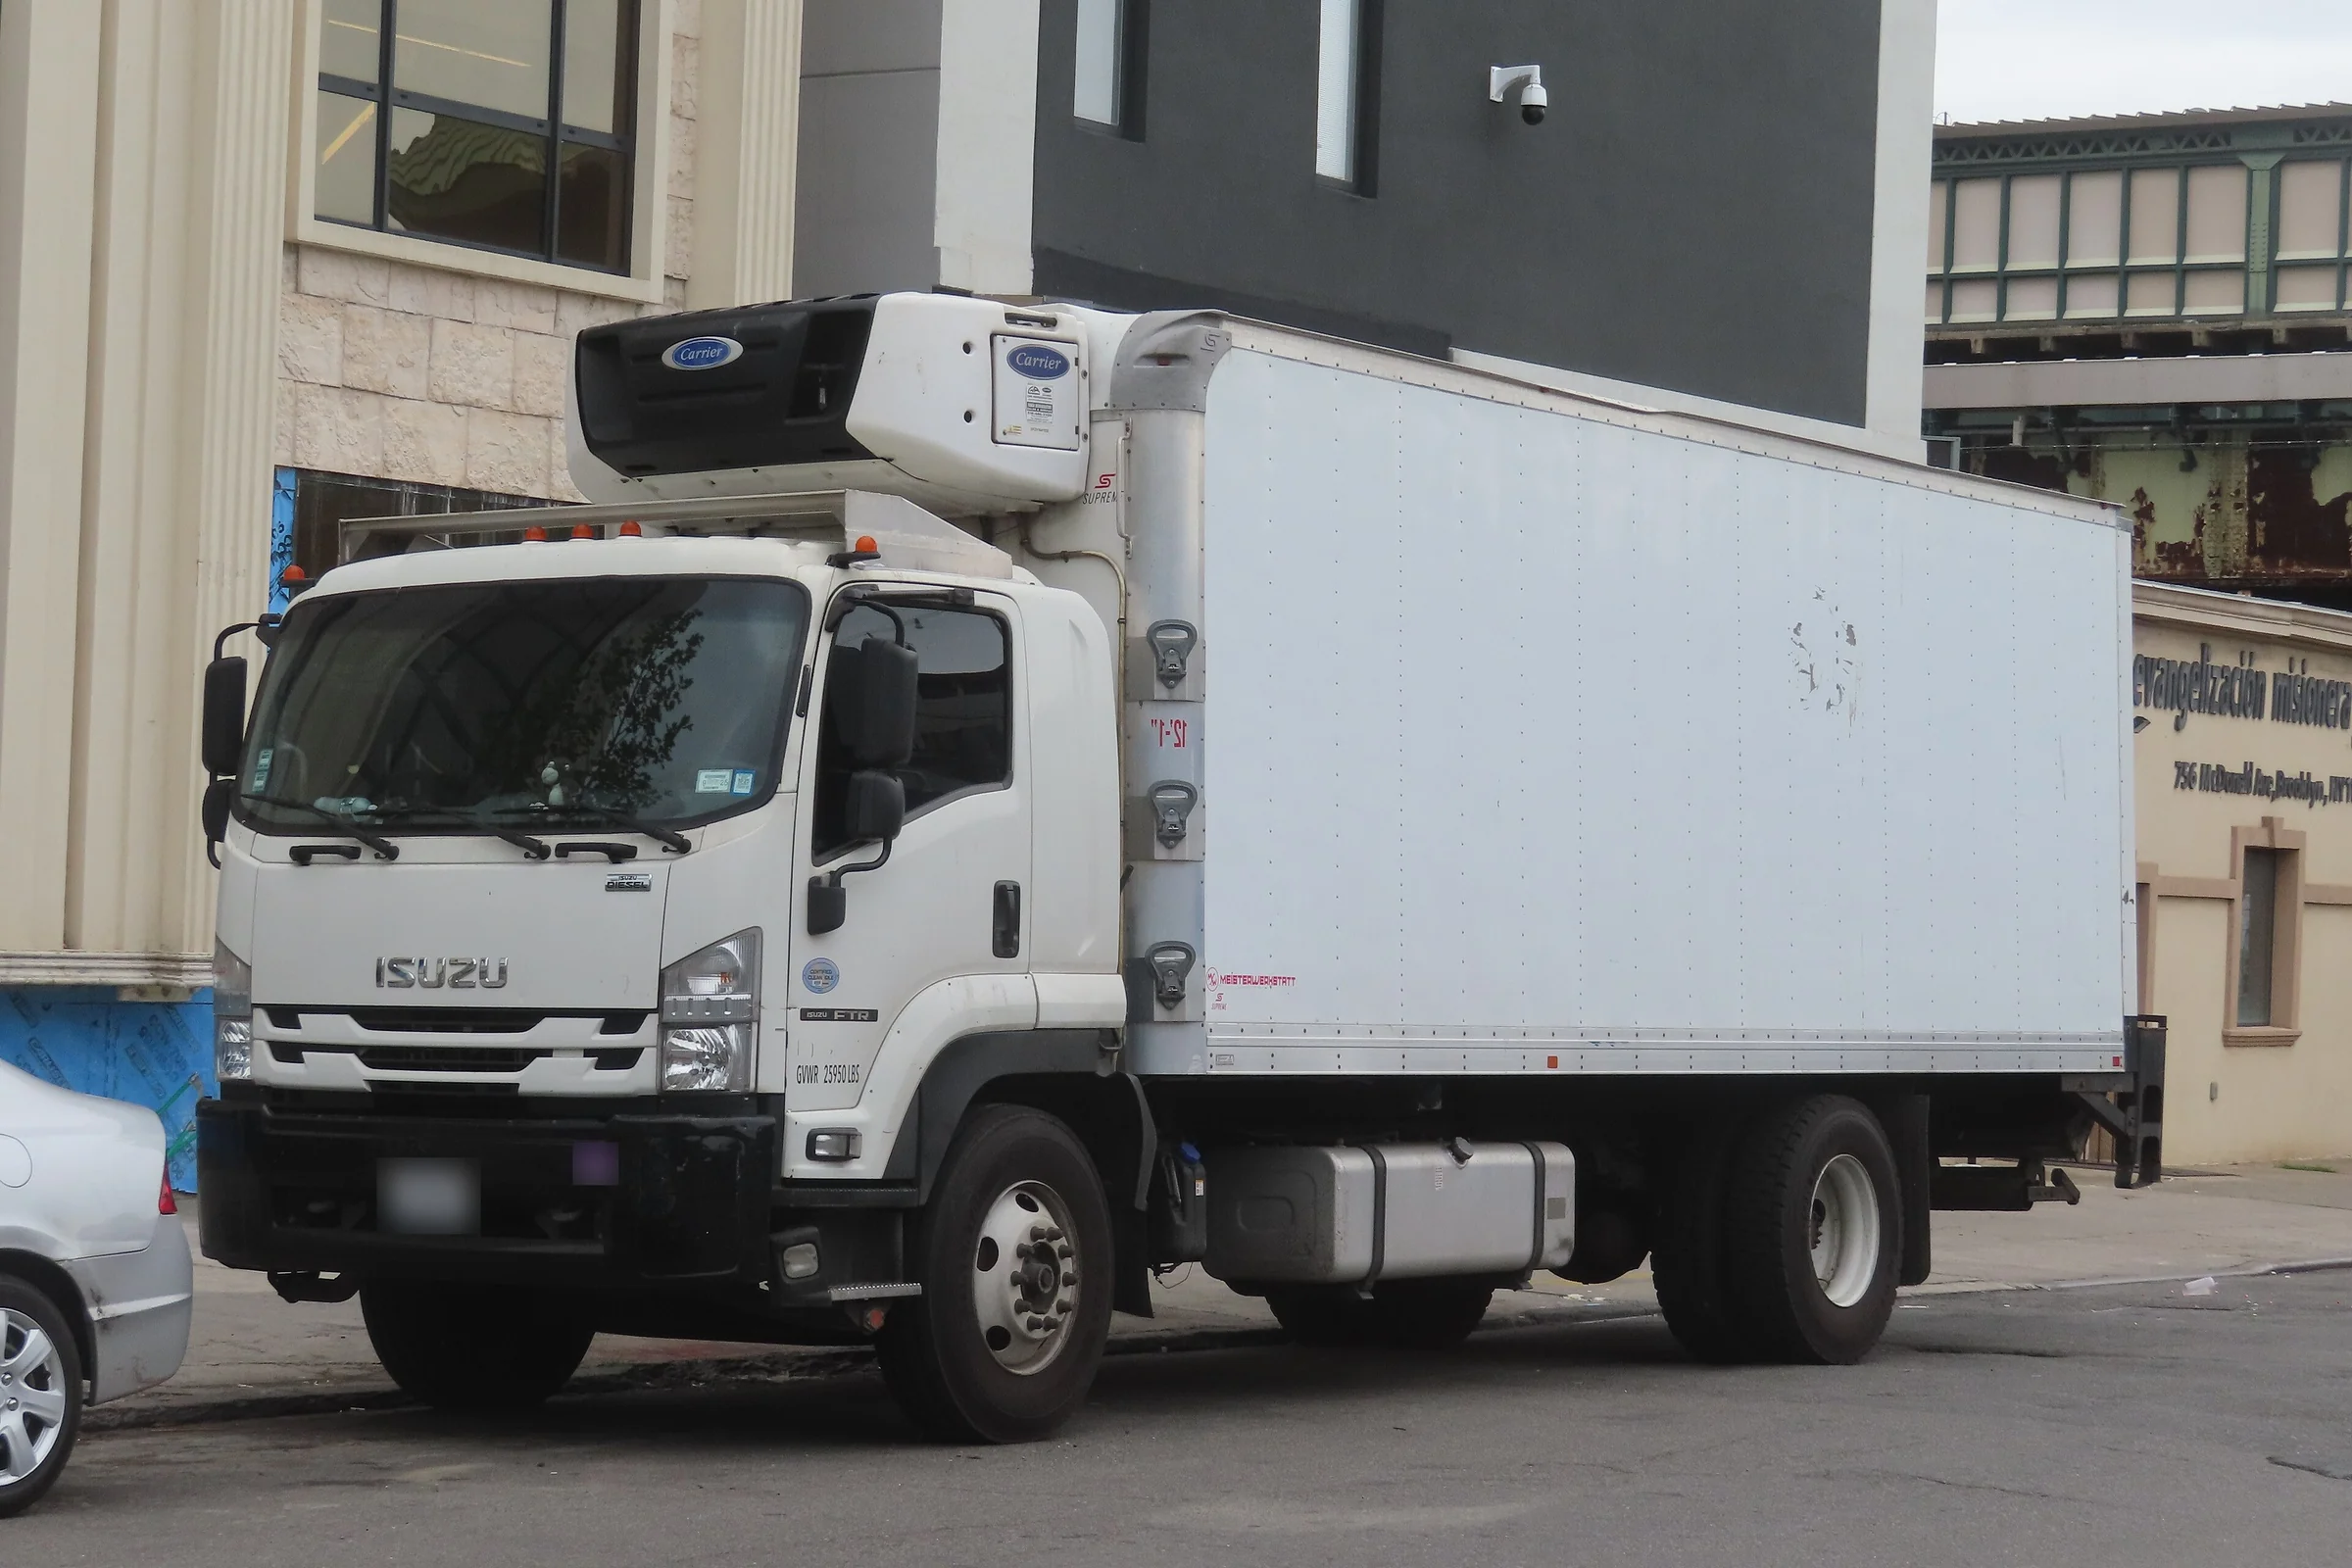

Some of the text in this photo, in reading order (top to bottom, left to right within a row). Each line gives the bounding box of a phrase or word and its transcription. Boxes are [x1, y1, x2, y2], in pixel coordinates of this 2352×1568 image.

[680, 347, 722, 361] Carrier
[1016, 352, 1061, 369] Carrier
[2174, 760, 2197, 790] 756
[2199, 760, 2254, 795] McDonald
[375, 956, 509, 989] ISUZU
[833, 1009, 869, 1020] FTR
[796, 1063, 860, 1085] GVWR 25950 LBS
